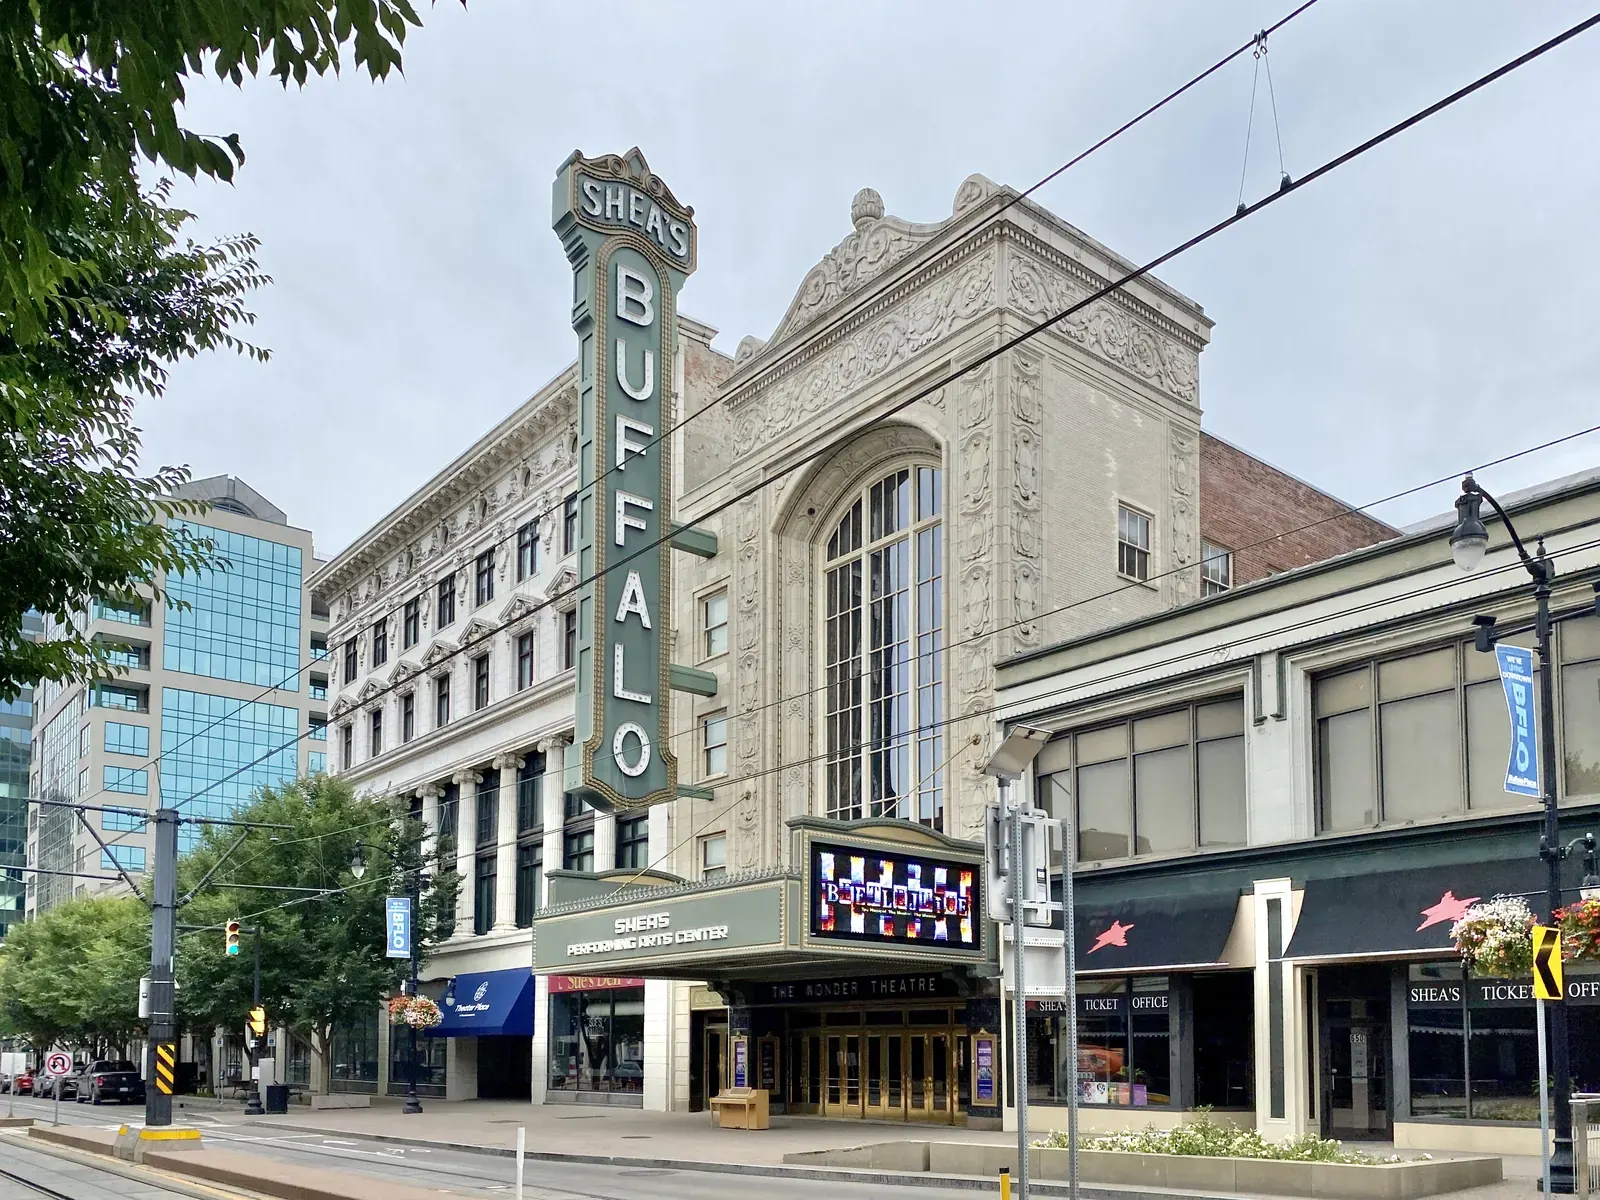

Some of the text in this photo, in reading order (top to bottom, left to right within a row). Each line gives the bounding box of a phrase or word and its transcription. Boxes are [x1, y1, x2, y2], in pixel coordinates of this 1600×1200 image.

[581, 178, 688, 258] SHEA'S
[613, 262, 655, 778] BUFFALO
[1512, 682, 1529, 773] BFLO
[393, 912, 404, 948] BFLO
[566, 925, 729, 956] PERFORMING ARTS CENTER
[772, 977, 936, 998] THE WONDER THEATRE
[1084, 998, 1119, 1010] TICKET
[1132, 996, 1169, 1009] OFFICE
[1411, 987, 1460, 1002] SHEA'S
